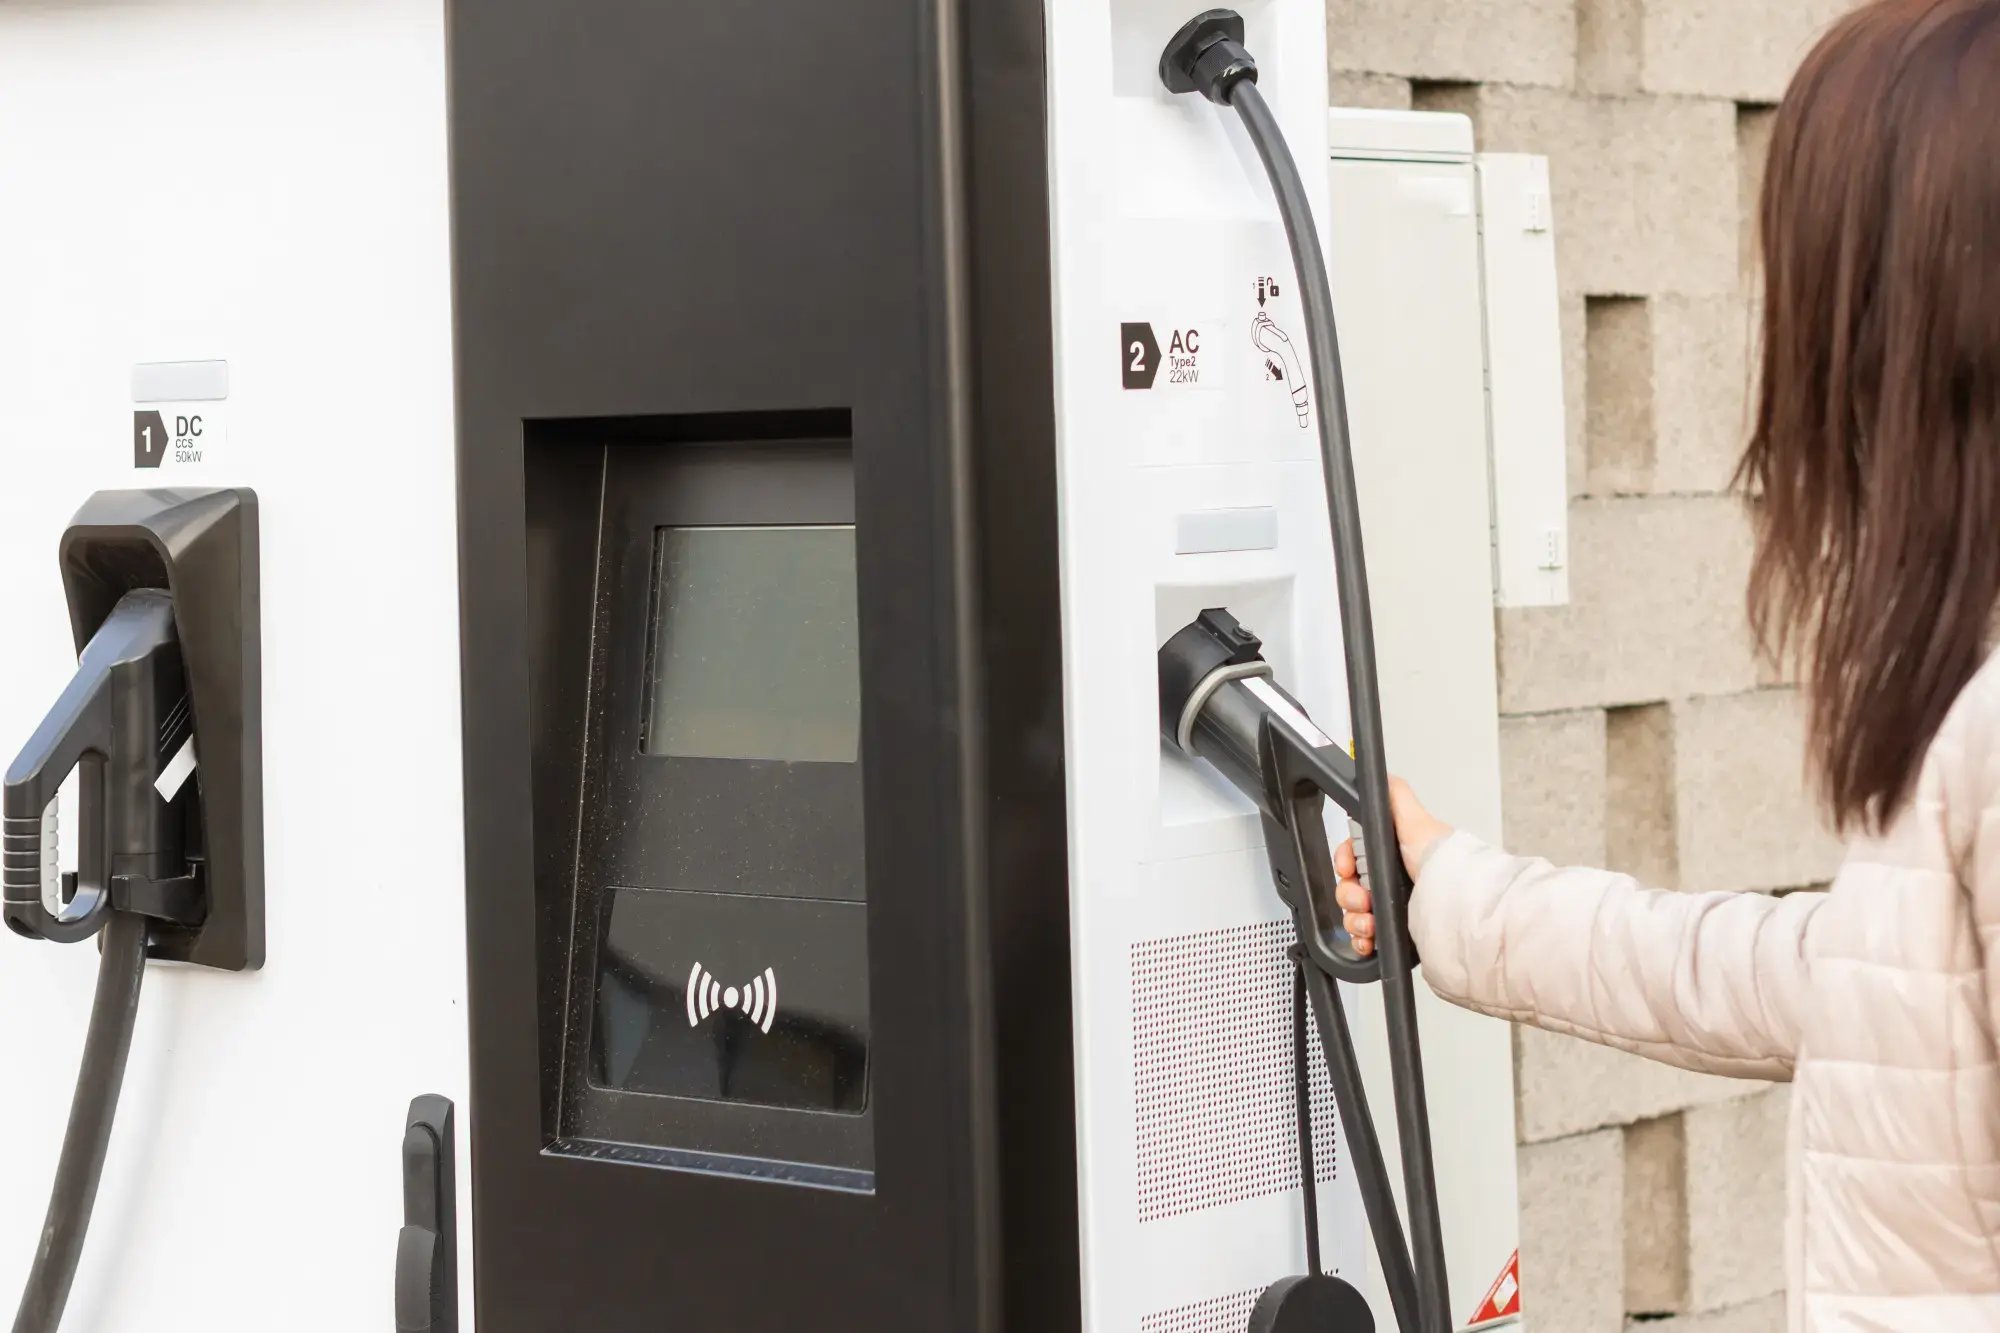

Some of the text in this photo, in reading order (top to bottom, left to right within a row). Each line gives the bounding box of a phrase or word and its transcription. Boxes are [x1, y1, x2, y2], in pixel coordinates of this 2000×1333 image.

[1169, 329, 1200, 354] AC
[1129, 341, 1146, 372] 2
[1169, 355, 1196, 370] Type2
[1169, 369, 1200, 383] 22kW
[176, 415, 203, 437] DC
[141, 426, 152, 453] 1
[175, 438, 194, 449] CCS
[175, 450, 203, 463] 50kW
